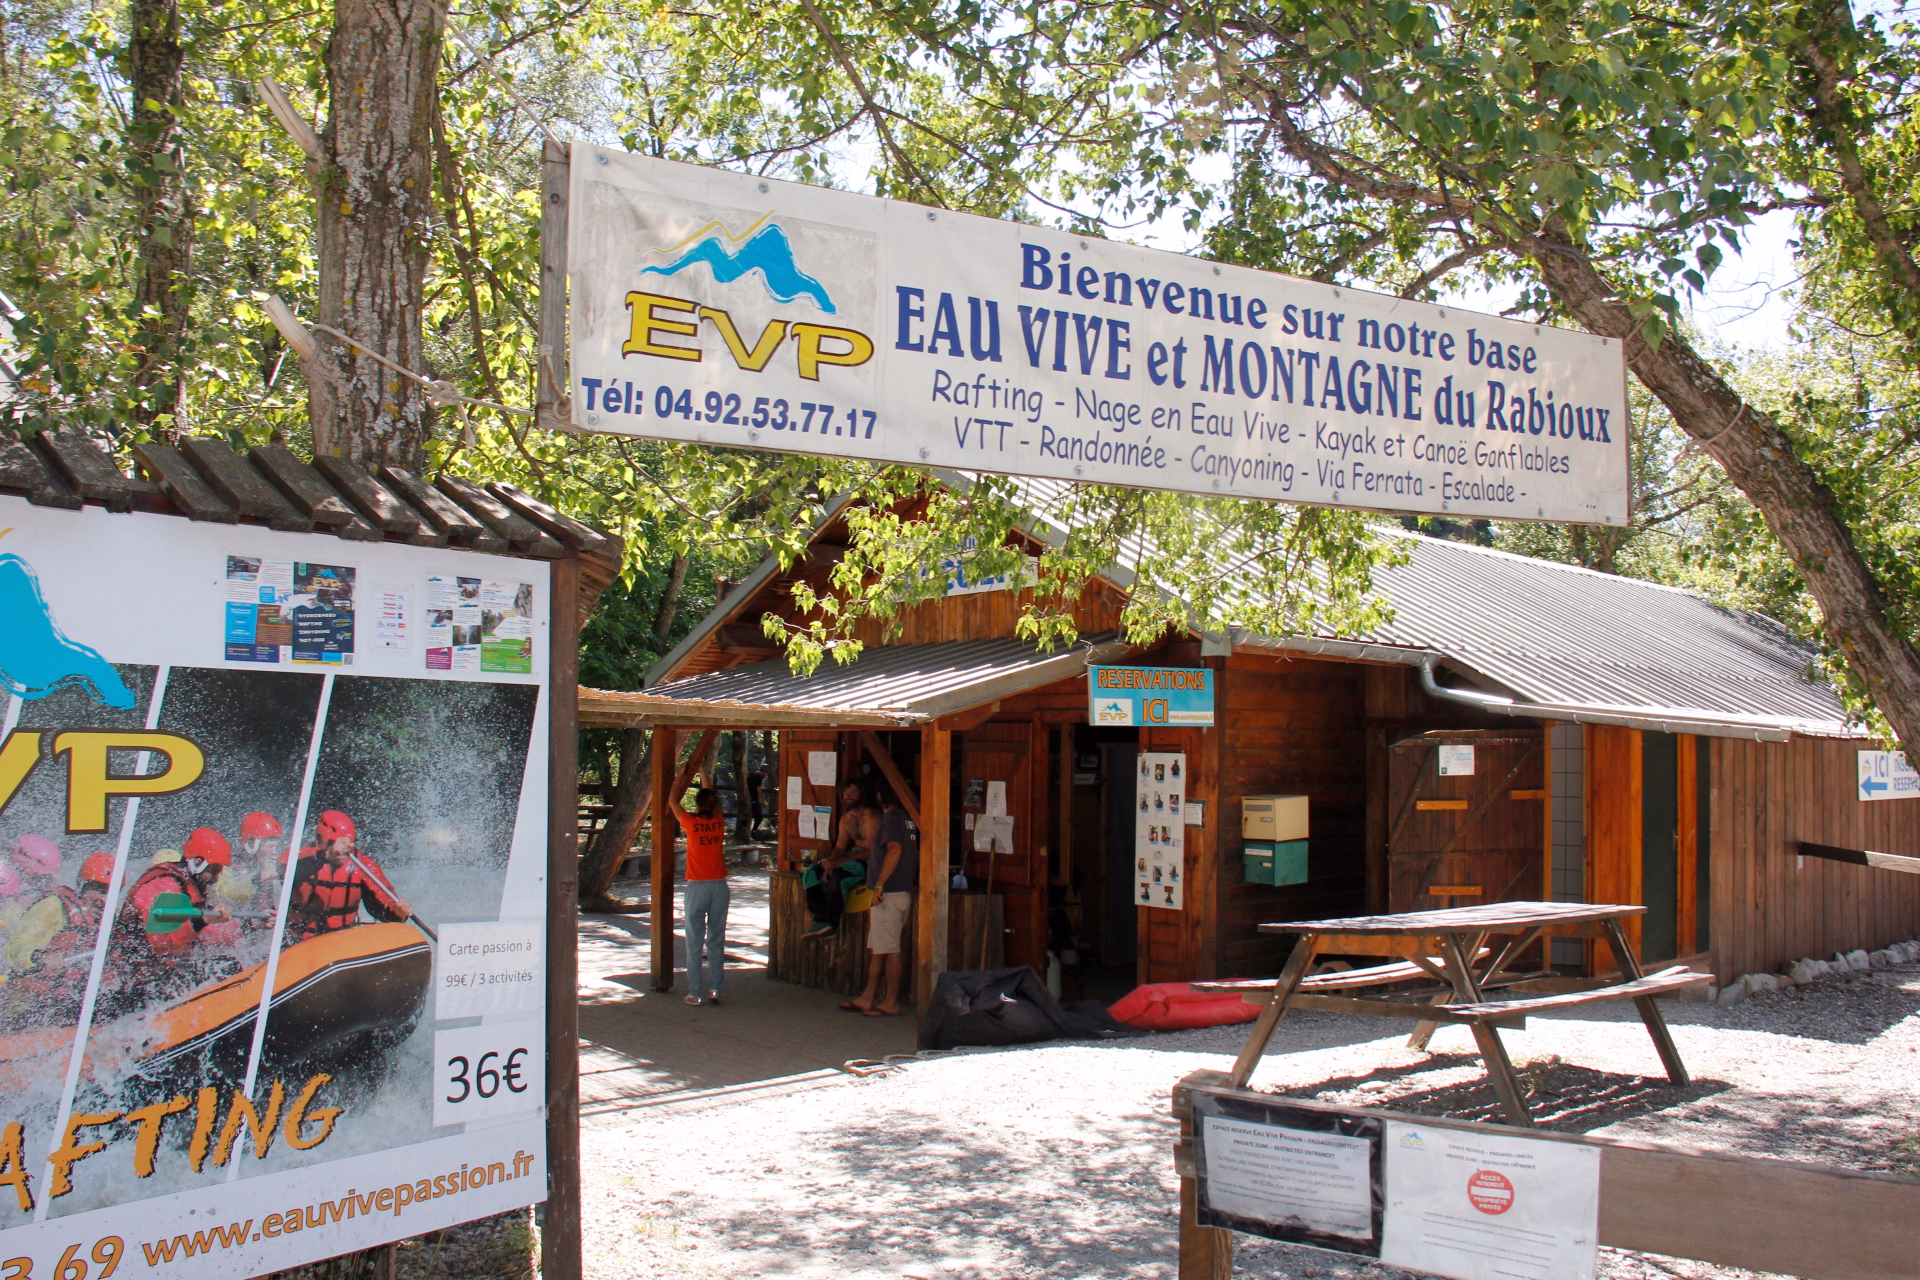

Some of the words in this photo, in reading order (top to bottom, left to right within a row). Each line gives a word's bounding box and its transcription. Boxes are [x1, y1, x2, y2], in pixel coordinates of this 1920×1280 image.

[1020, 242, 1268, 329] Bienvenue
[1282, 303, 1345, 342] sur
[1358, 318, 1456, 361] notre
[1467, 328, 1537, 373] base
[622, 290, 874, 381] EVP
[895, 285, 1002, 363] EAU
[1017, 304, 1131, 381] VIVE
[1147, 336, 1187, 389] et
[1200, 334, 1422, 421] MONTAGNE
[1434, 375, 1475, 428] du
[1486, 381, 1611, 443] Rabioux
[581, 377, 644, 415] Tél:
[654, 385, 877, 439] 04.92.53.77.17
[932, 369, 1044, 423] Rafting
[1076, 387, 1142, 433] Nage
[1151, 406, 1181, 431] en
[1191, 403, 1234, 438] Eau
[1244, 410, 1291, 444] Vive
[1316, 420, 1376, 460] Kayak
[1383, 433, 1405, 458] et
[1413, 434, 1468, 466] Canoë
[1474, 440, 1570, 474] Gonflables
[954, 416, 1013, 451] VTT
[1040, 424, 1166, 469] Randonnée
[1190, 444, 1294, 491] Canyoning
[1317, 458, 1344, 488] Via
[1352, 462, 1423, 497] Ferrata
[1443, 471, 1515, 502] Escalade
[1097, 668, 1205, 690] RESERVATIONS
[1099, 712, 1128, 721] EVP
[1142, 699, 1168, 723] ICI
[1875, 754, 1889, 778] ICI
[693, 821, 723, 833] STAFF
[700, 835, 720, 845] EVP
[449, 943, 479, 956] Carte
[482, 940, 522, 957] passion
[525, 939, 532, 951] à
[446, 974, 468, 987] 99€
[470, 972, 476, 987] /
[479, 973, 486, 985] 3
[488, 969, 533, 984] activités
[446, 1047, 528, 1103] 36€
[1212, 1124, 1230, 1132] ESPACE
[1231, 1127, 1252, 1135] RESERVE
[1308, 1138, 1335, 1147] PASSAGES
[1400, 1137, 1424, 1147] EVP
[1233, 1139, 1254, 1147] PRIVATE
[1273, 1145, 1304, 1154] RESTRICTED
[1465, 1146, 1485, 1155] RESERVE
[1446, 1153, 1465, 1161] PRIVATE
[1482, 1159, 1510, 1167] RESTRICTED
[1476, 1180, 1506, 1188] INTERDIT
[142, 1150, 534, 1267] www.eauvivepassion.fr
[1473, 1196, 1508, 1206] PROPRIÉTÉ
[1478, 1202, 1502, 1211] PRIVÉE
